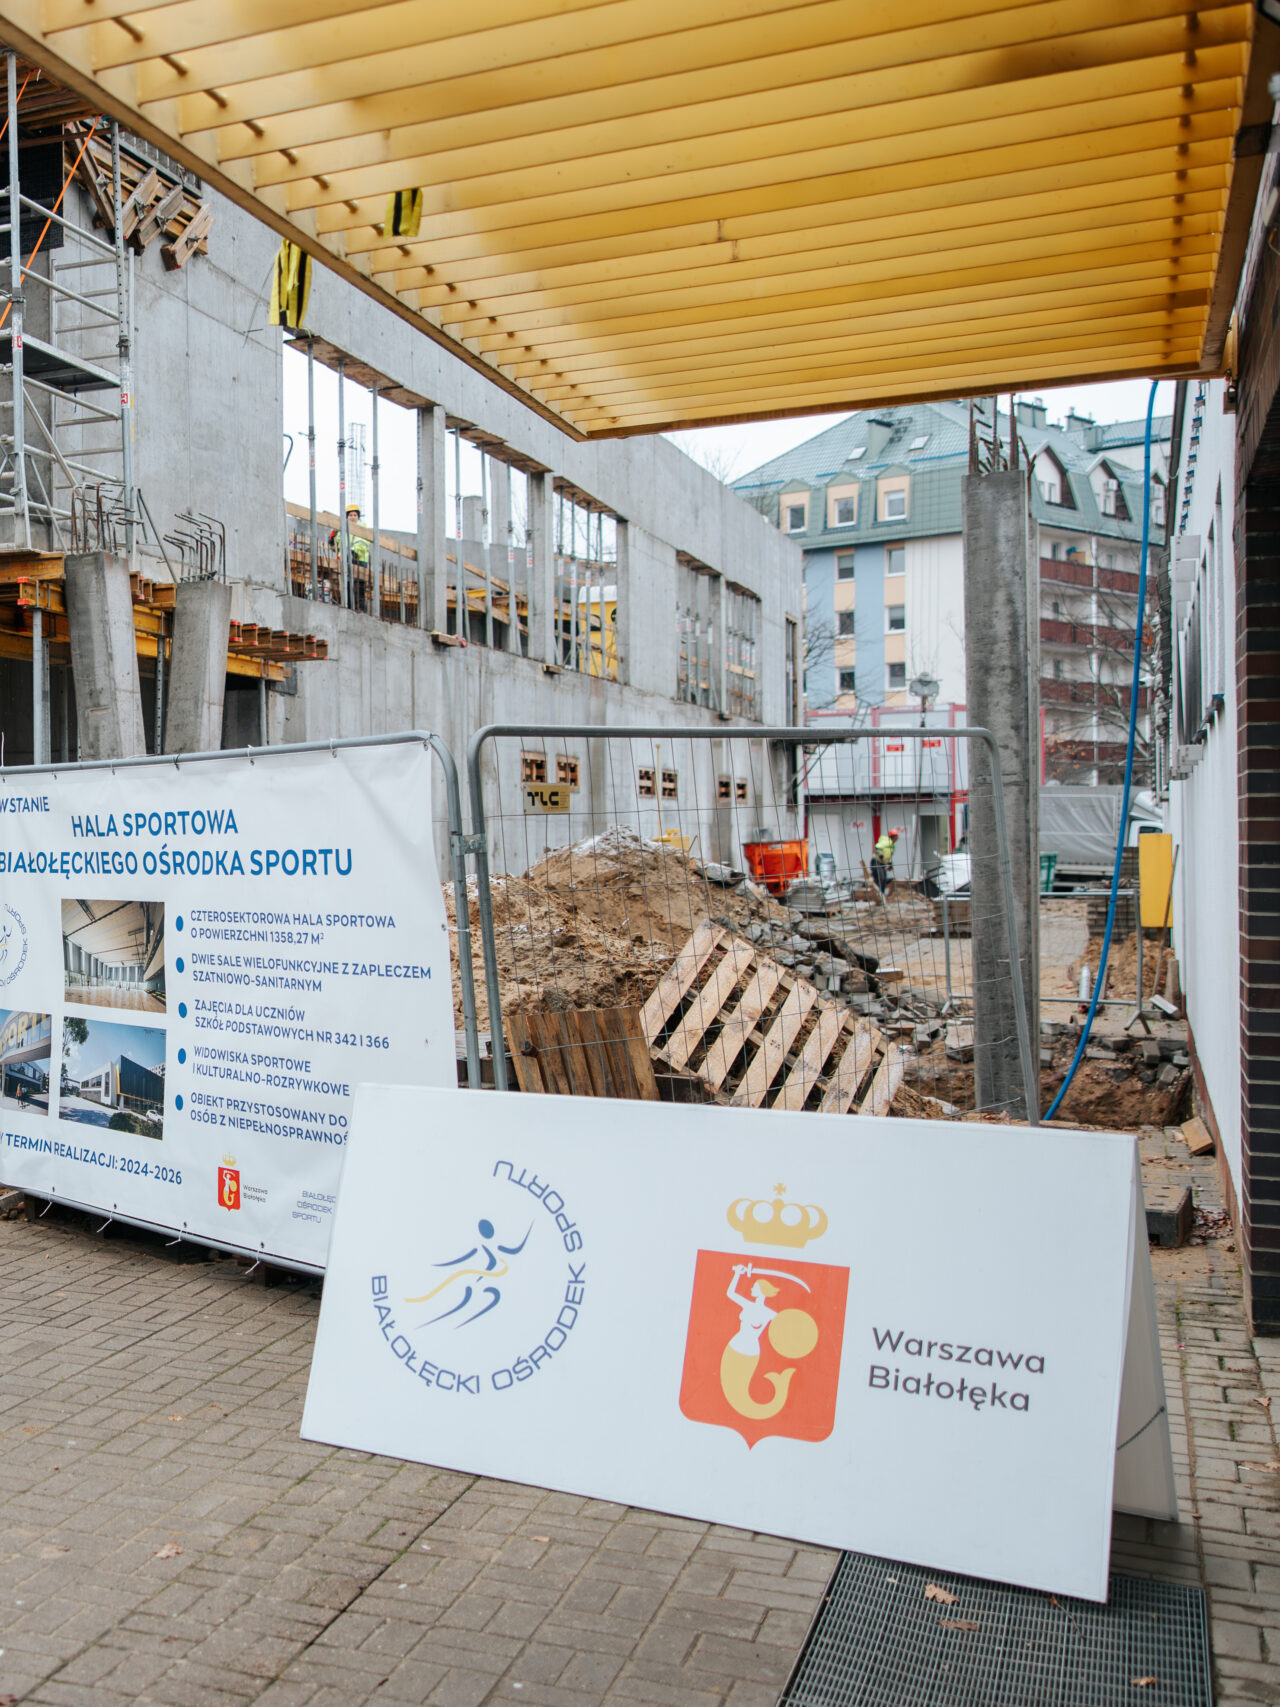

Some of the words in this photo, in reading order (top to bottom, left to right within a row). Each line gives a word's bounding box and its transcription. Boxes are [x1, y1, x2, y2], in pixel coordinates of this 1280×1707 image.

[527, 791, 559, 806] TLC
[71, 813, 118, 838] HALA
[122, 808, 239, 837] SPORTOWA
[142, 843, 245, 876] OŚRODKA
[250, 848, 353, 876] SPORTU
[190, 910, 290, 925] CZTEROSEKTOROWA
[292, 913, 324, 927] HALA
[325, 914, 396, 929] SPORTOWA
[190, 927, 198, 939] O
[199, 928, 268, 942] POWIERZCHNI
[270, 931, 309, 945] 1358,27
[191, 952, 216, 966] DWIE
[217, 954, 242, 968] SALE
[243, 956, 339, 974] WIELOFUNKCYJNE
[341, 962, 350, 975] Z
[352, 963, 432, 979] ZAPLECZEM
[193, 970, 322, 993] SZATNIOWO-SANITARNYM
[194, 999, 233, 1017] ZAJĘCIA
[235, 1003, 254, 1017] DLA
[255, 1006, 305, 1022] UCZNIÓW
[195, 1015, 224, 1031] SZKÓŁ
[225, 1020, 314, 1042] PODSTAWOWYCH
[316, 1030, 333, 1043] NR
[334, 1032, 357, 1046] 342
[366, 1035, 390, 1049] 366
[194, 1045, 249, 1065] WIDOWISKA
[251, 1054, 312, 1073] SPORTOWE
[196, 1065, 350, 1096] KULTURALNO-ROZRYWKOWE
[190, 1092, 225, 1108] OBIEKT
[226, 1098, 326, 1125] PRZYSTOSOWANY
[328, 1113, 348, 1128] DO
[190, 1108, 218, 1125] OSÓB
[219, 1114, 227, 1126] Z
[5, 1133, 52, 1154] TERMIN
[53, 1141, 119, 1170] REALIZACJI:
[119, 1157, 183, 1185] 2024-2026
[292, 1211, 321, 1223] SPORTU
[493, 1160, 583, 1253] SPORTU
[371, 1275, 481, 1394] BIAŁOŁĘCKI
[491, 1261, 586, 1391] OŚRODEK
[872, 1326, 1045, 1374] Warszawa
[868, 1364, 1030, 1411] Białołęka
